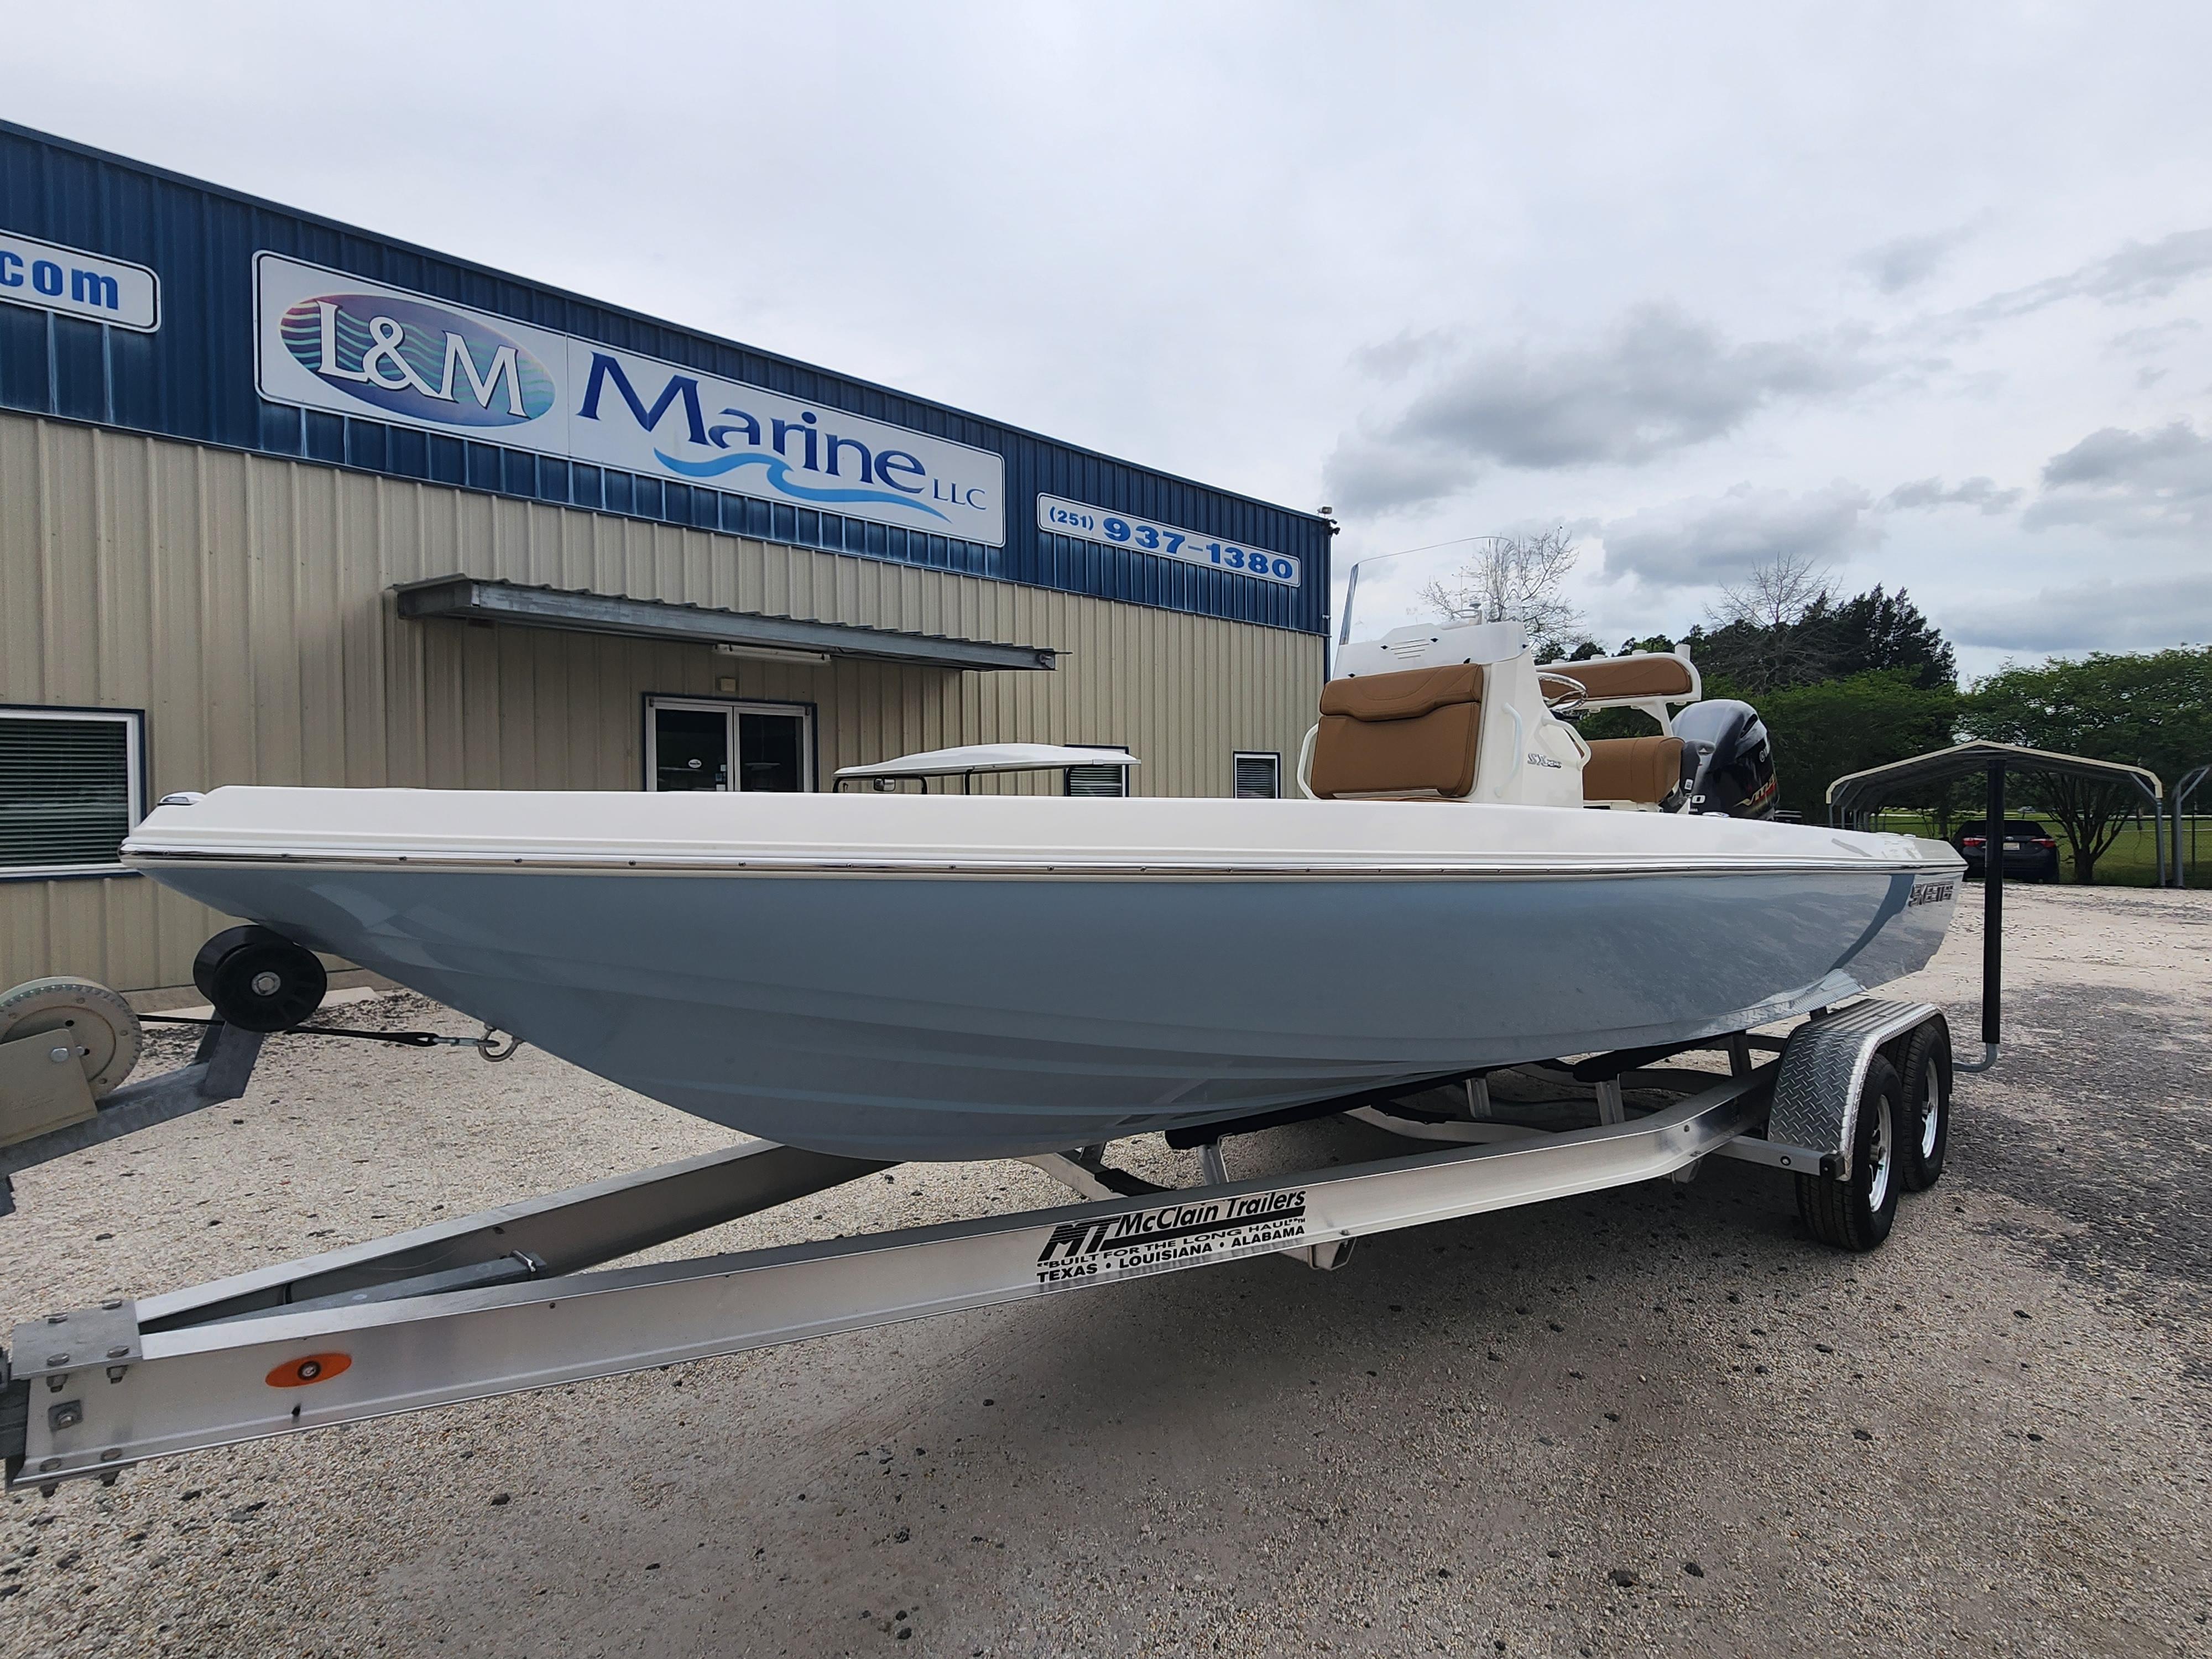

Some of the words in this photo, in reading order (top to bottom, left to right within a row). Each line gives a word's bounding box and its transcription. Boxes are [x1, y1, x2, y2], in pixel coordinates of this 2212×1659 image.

[0, 251, 119, 310] com
[315, 300, 531, 420] L&M
[576, 351, 926, 494] Marine
[932, 477, 987, 511] LLC
[1050, 506, 1094, 531] (251)
[1103, 517, 1293, 580] 937-1380
[1115, 1203, 1219, 1237] McClain
[1223, 1191, 1306, 1218] Trailers
[1037, 1263, 1098, 1283] TEXAS
[1119, 1243, 1213, 1269] LOUISIANA
[1231, 1225, 1305, 1248] ALABAMA
[1104, 1247, 1140, 1259] FOR
[1145, 1240, 1176, 1251] THE
[1183, 1229, 1242, 1245] LONG
